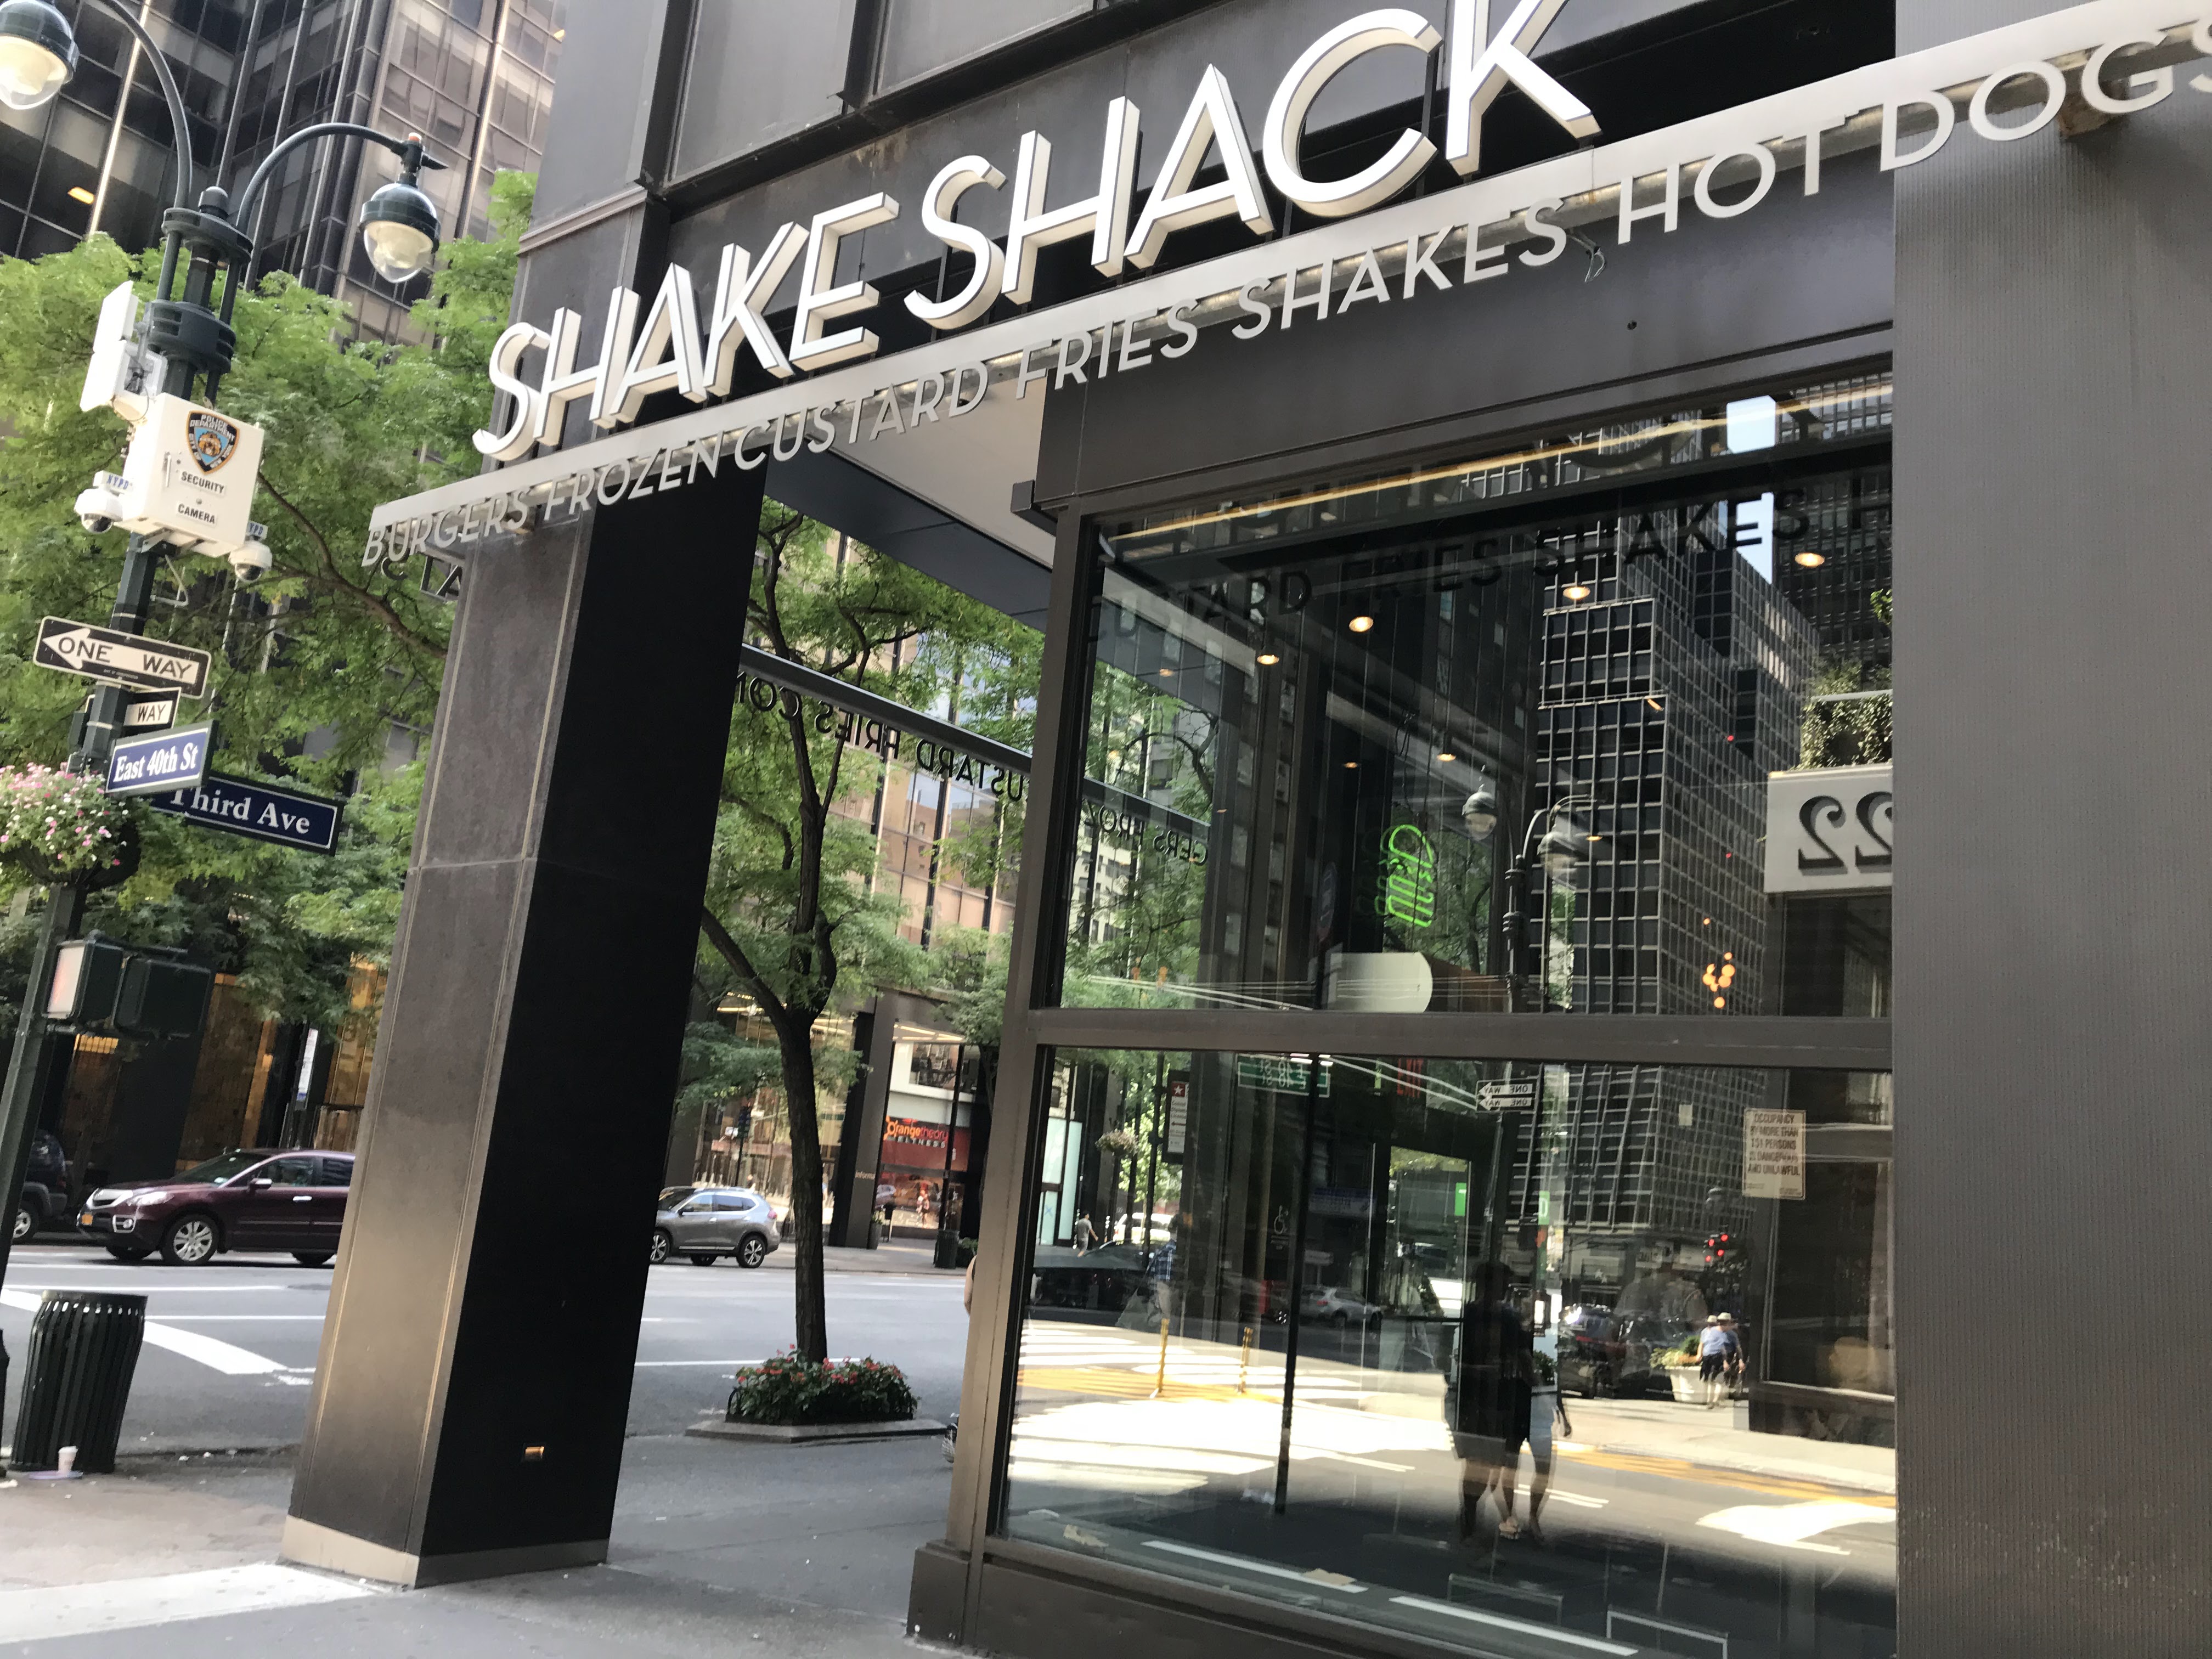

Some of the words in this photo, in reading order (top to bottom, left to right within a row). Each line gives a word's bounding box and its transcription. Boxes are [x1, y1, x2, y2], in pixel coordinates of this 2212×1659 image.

[472, 191, 900, 461] SHAKE
[904, 0, 1602, 329] SHACK
[362, 490, 529, 567] BURGERS
[544, 430, 725, 521] FROZEN
[734, 359, 988, 471] CUSTARD
[1015, 298, 1199, 399] FRIES
[1231, 196, 1568, 339] SHAKES
[1618, 112, 1847, 245] HOT
[190, 419, 235, 442] DEPARTMENT
[201, 414, 228, 428] POLICE
[106, 474, 129, 490] NYPD
[180, 471, 225, 494] SECURITY
[178, 503, 216, 524] CAMERA
[249, 522, 263, 535] YPD
[58, 637, 113, 663] ONE
[143, 653, 192, 679] WAY
[137, 704, 167, 723] WAY
[113, 755, 145, 782] East
[146, 746, 178, 776] 40th
[180, 743, 198, 770] St
[170, 787, 251, 821] Third
[257, 799, 310, 834] Ave
[1754, 1113, 1795, 1124] OCCUPANCY
[1759, 1126, 1780, 1136] MORE
[1781, 1126, 1799, 1137] THAN
[1765, 1138, 1797, 1150] PERSONS
